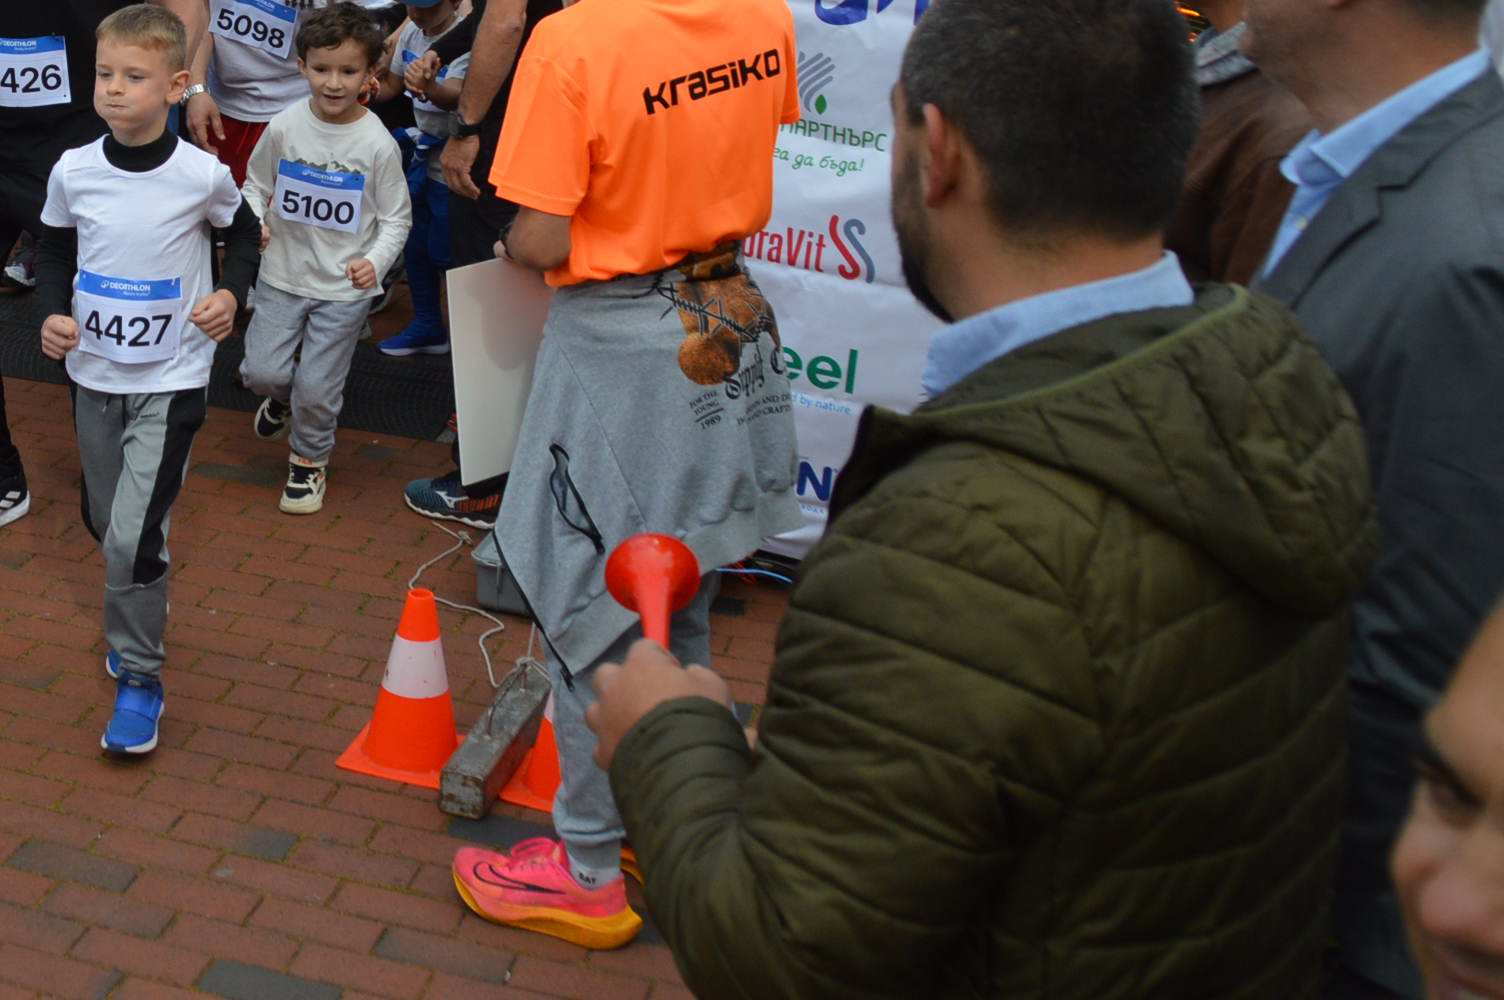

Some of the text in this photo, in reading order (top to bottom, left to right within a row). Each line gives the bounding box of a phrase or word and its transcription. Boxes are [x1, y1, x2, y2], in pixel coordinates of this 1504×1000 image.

[217, 8, 285, 49] 5098
[791, 152, 814, 170] да
[282, 189, 355, 224] 5100
[109, 281, 151, 291] DECATHLON
[84, 309, 173, 347] 4427
[783, 345, 859, 395] eel
[815, 400, 851, 415] nature
[700, 414, 722, 430] 1989
